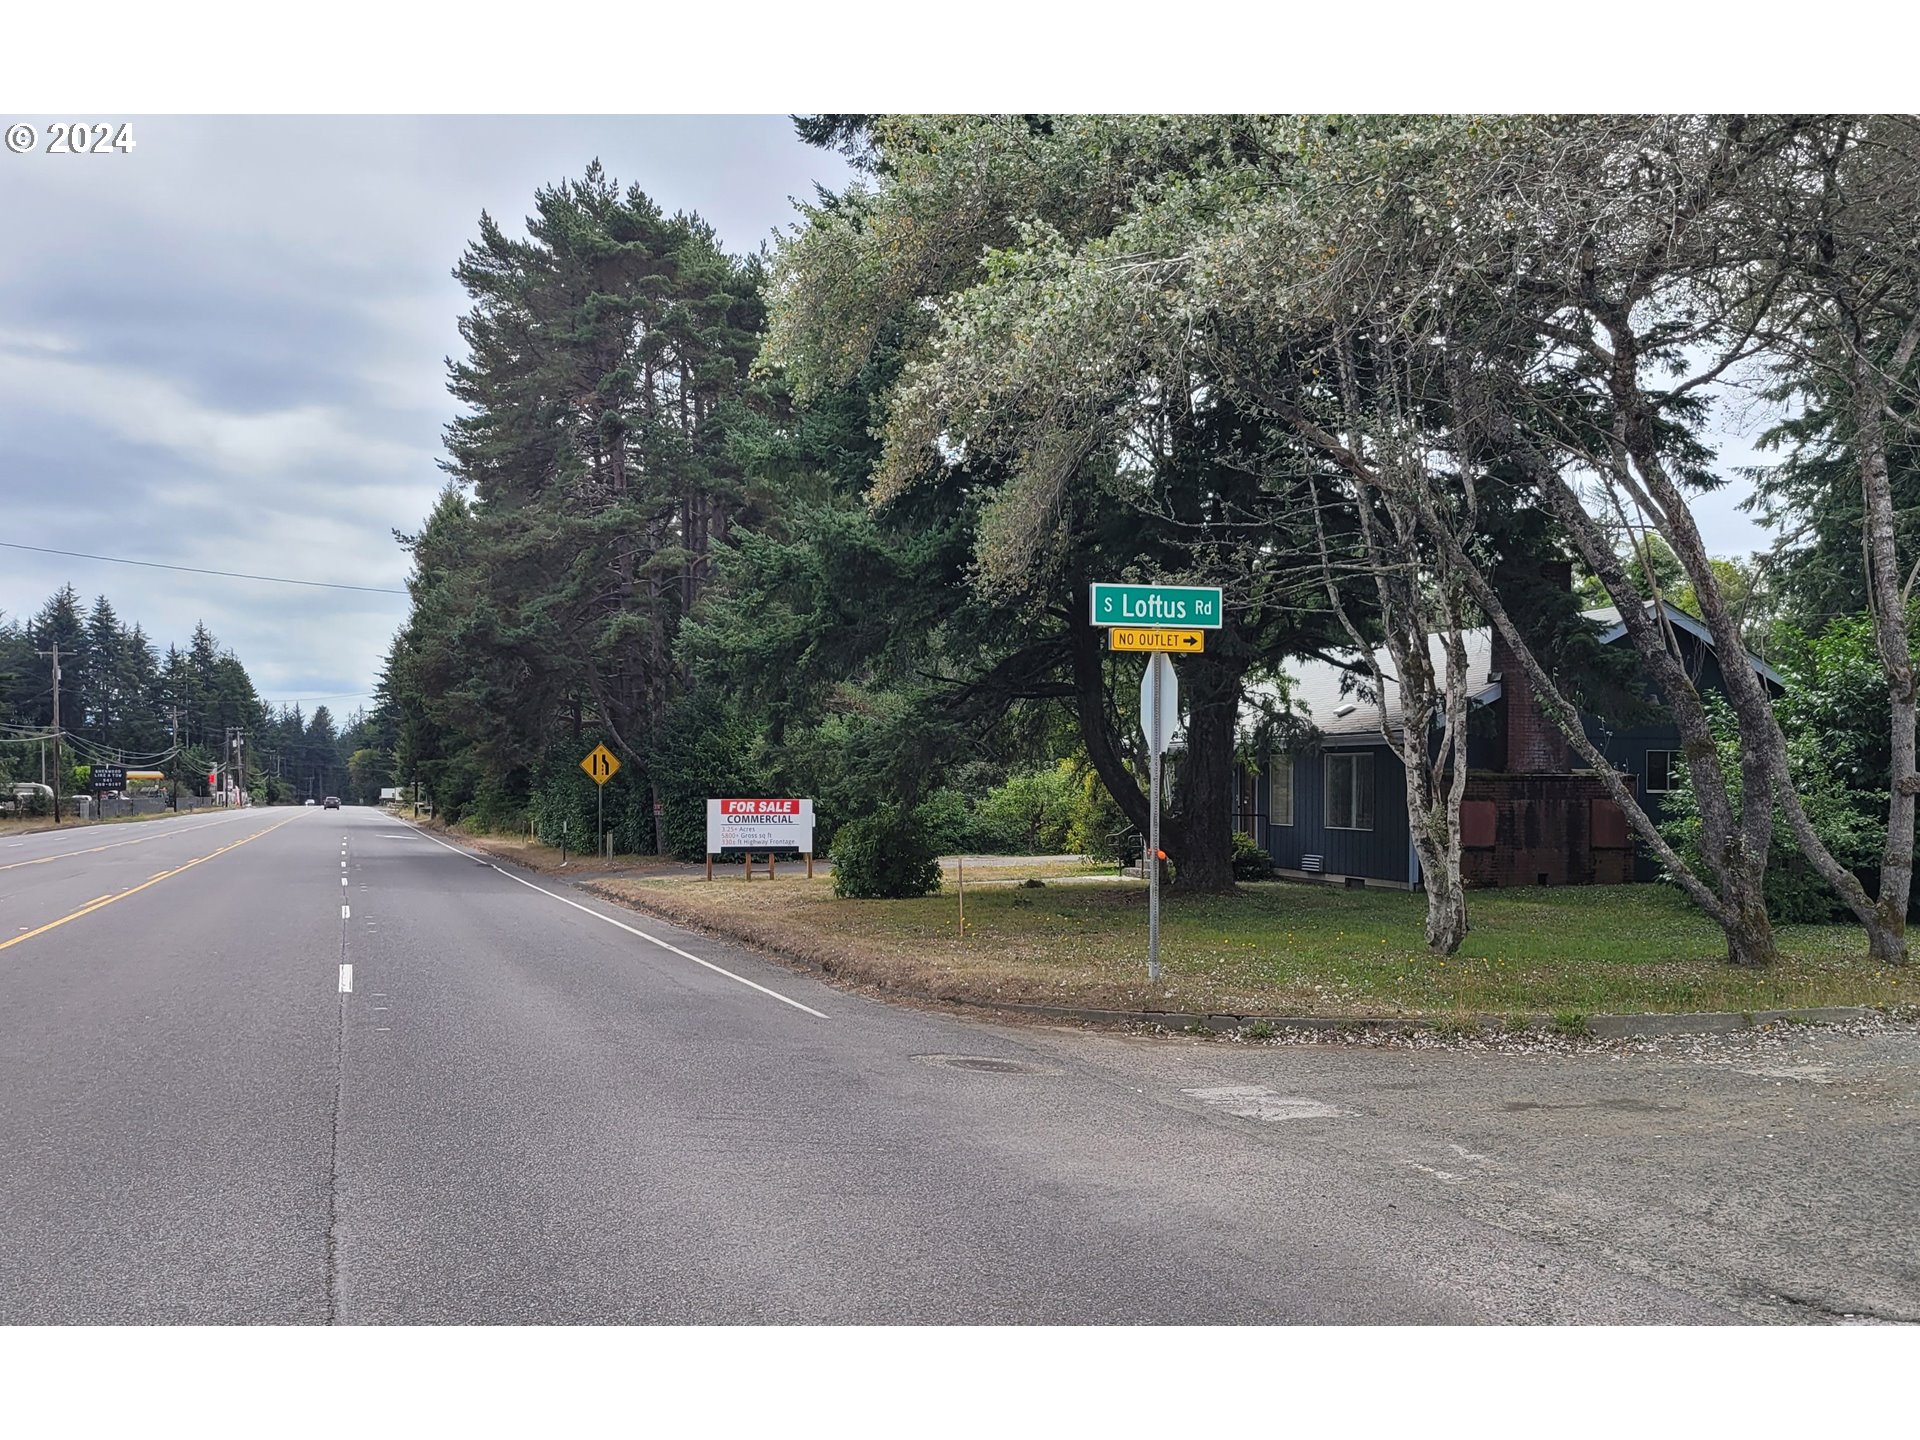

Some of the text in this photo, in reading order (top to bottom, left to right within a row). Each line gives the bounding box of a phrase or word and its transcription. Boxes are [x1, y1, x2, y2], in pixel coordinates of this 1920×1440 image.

[1103, 593, 1212, 619] S Loftus Rd
[1119, 634, 1180, 647] NO OUTLET
[728, 801, 792, 813] FOR SALE
[727, 815, 794, 824] COMMERCIAL
